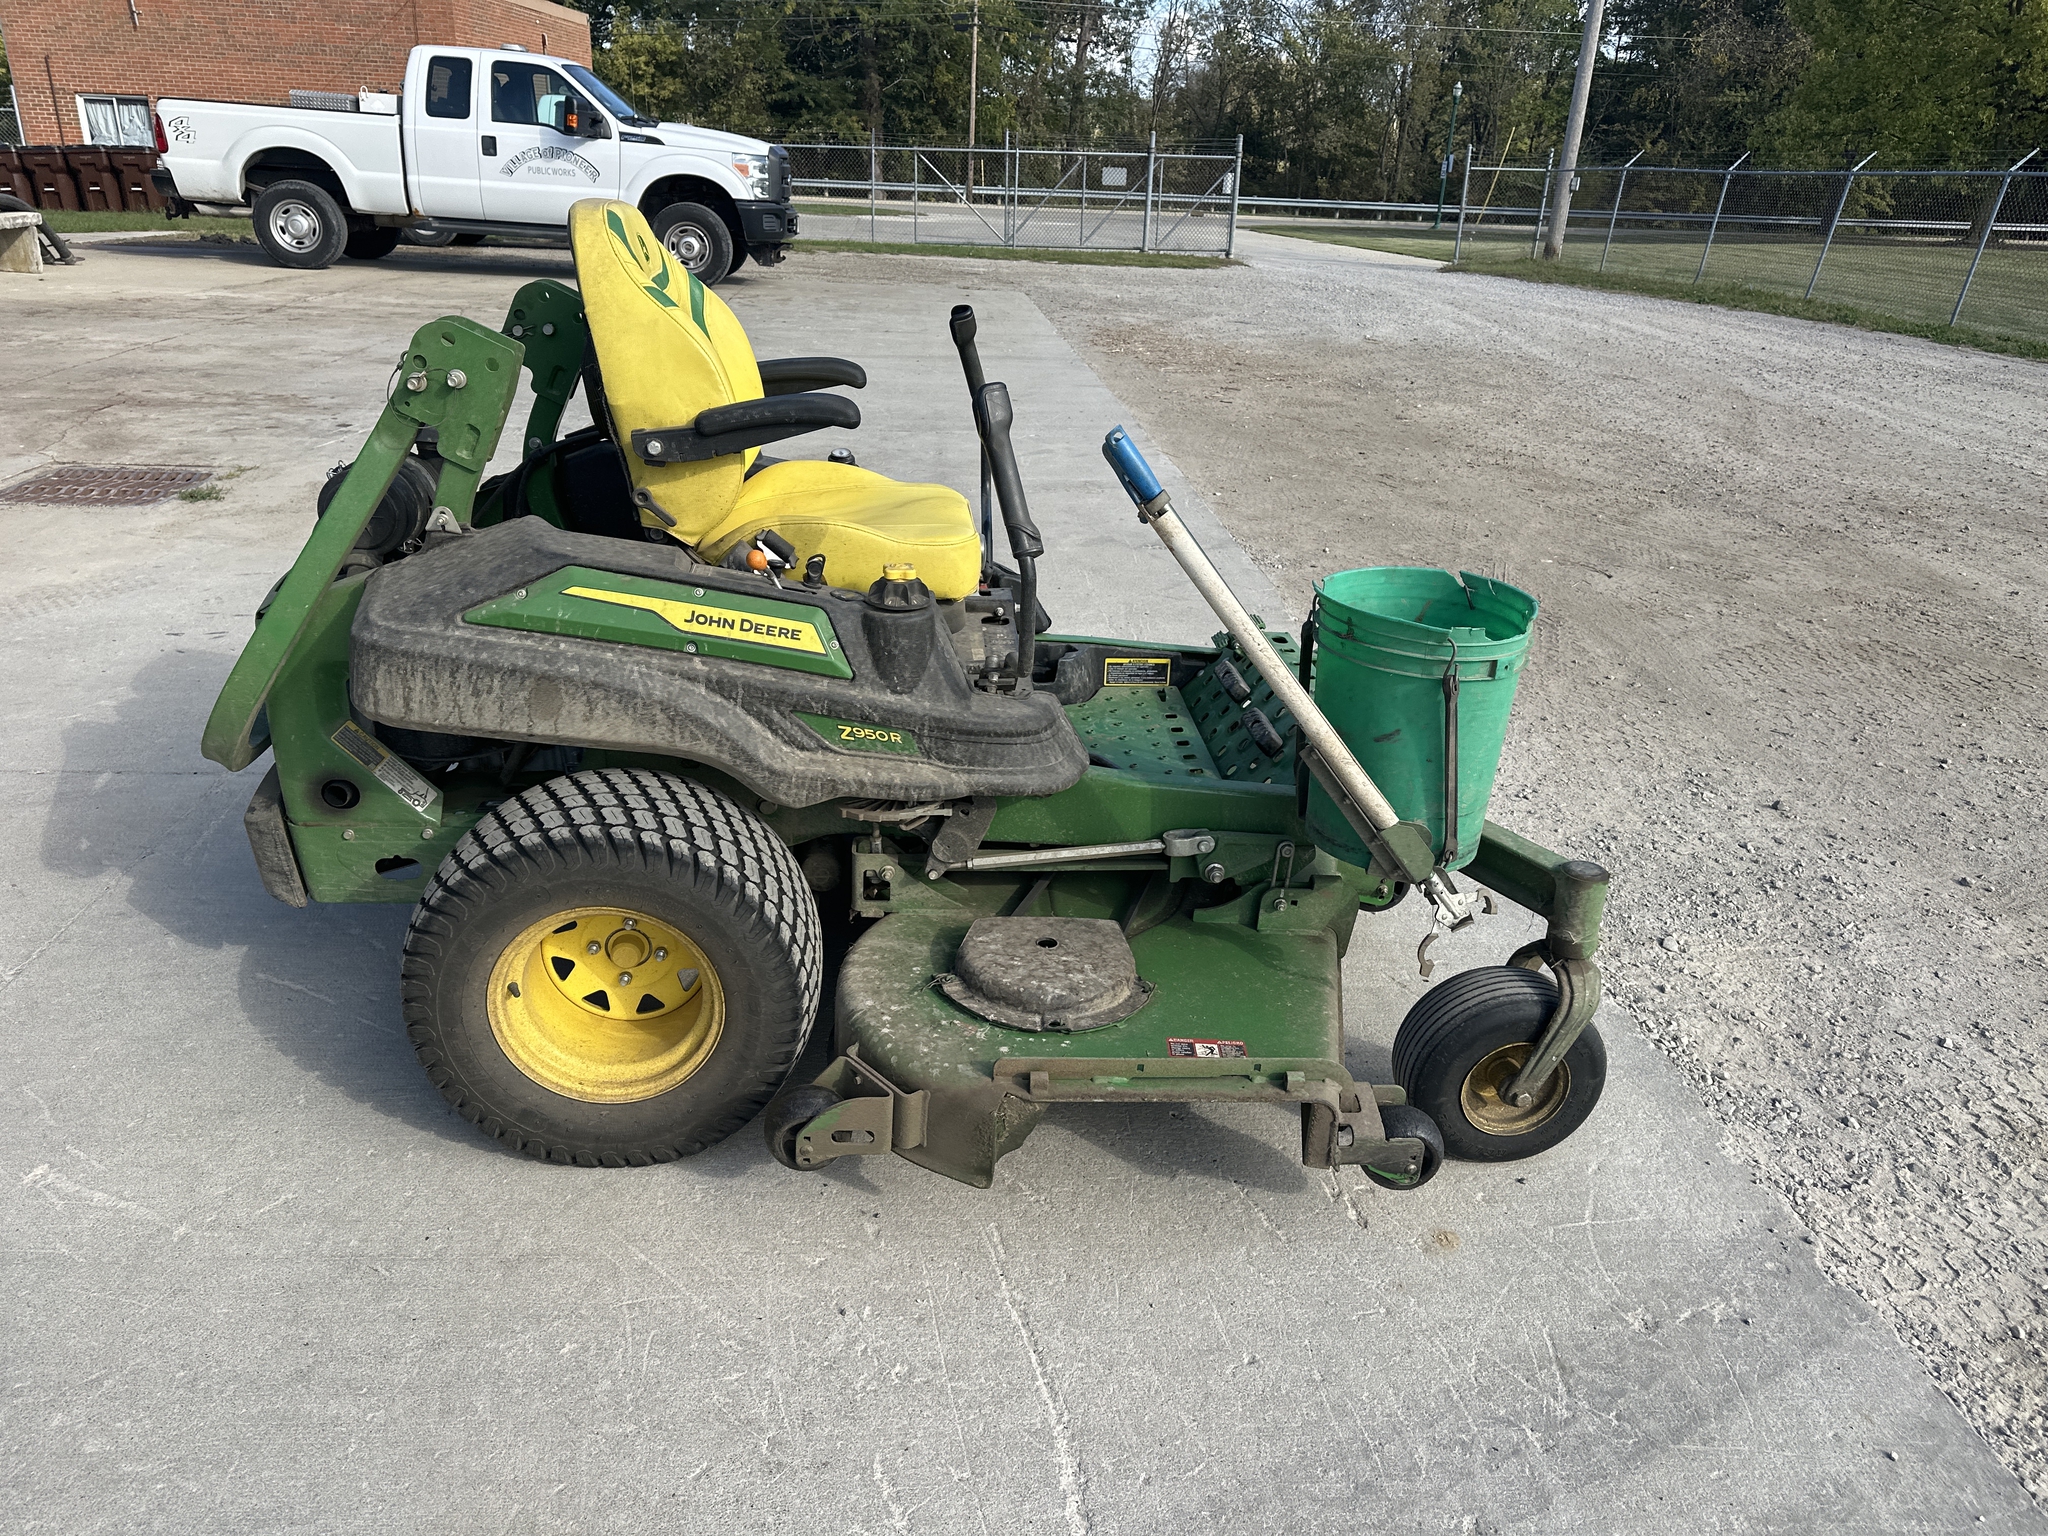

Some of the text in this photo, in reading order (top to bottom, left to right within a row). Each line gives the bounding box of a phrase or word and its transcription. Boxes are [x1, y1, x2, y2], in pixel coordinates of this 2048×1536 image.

[500, 145, 600, 183] VILLAGE of PIONEER
[527, 166, 576, 177] PUBLIC WORKS
[683, 610, 802, 641] JOHN DEERE
